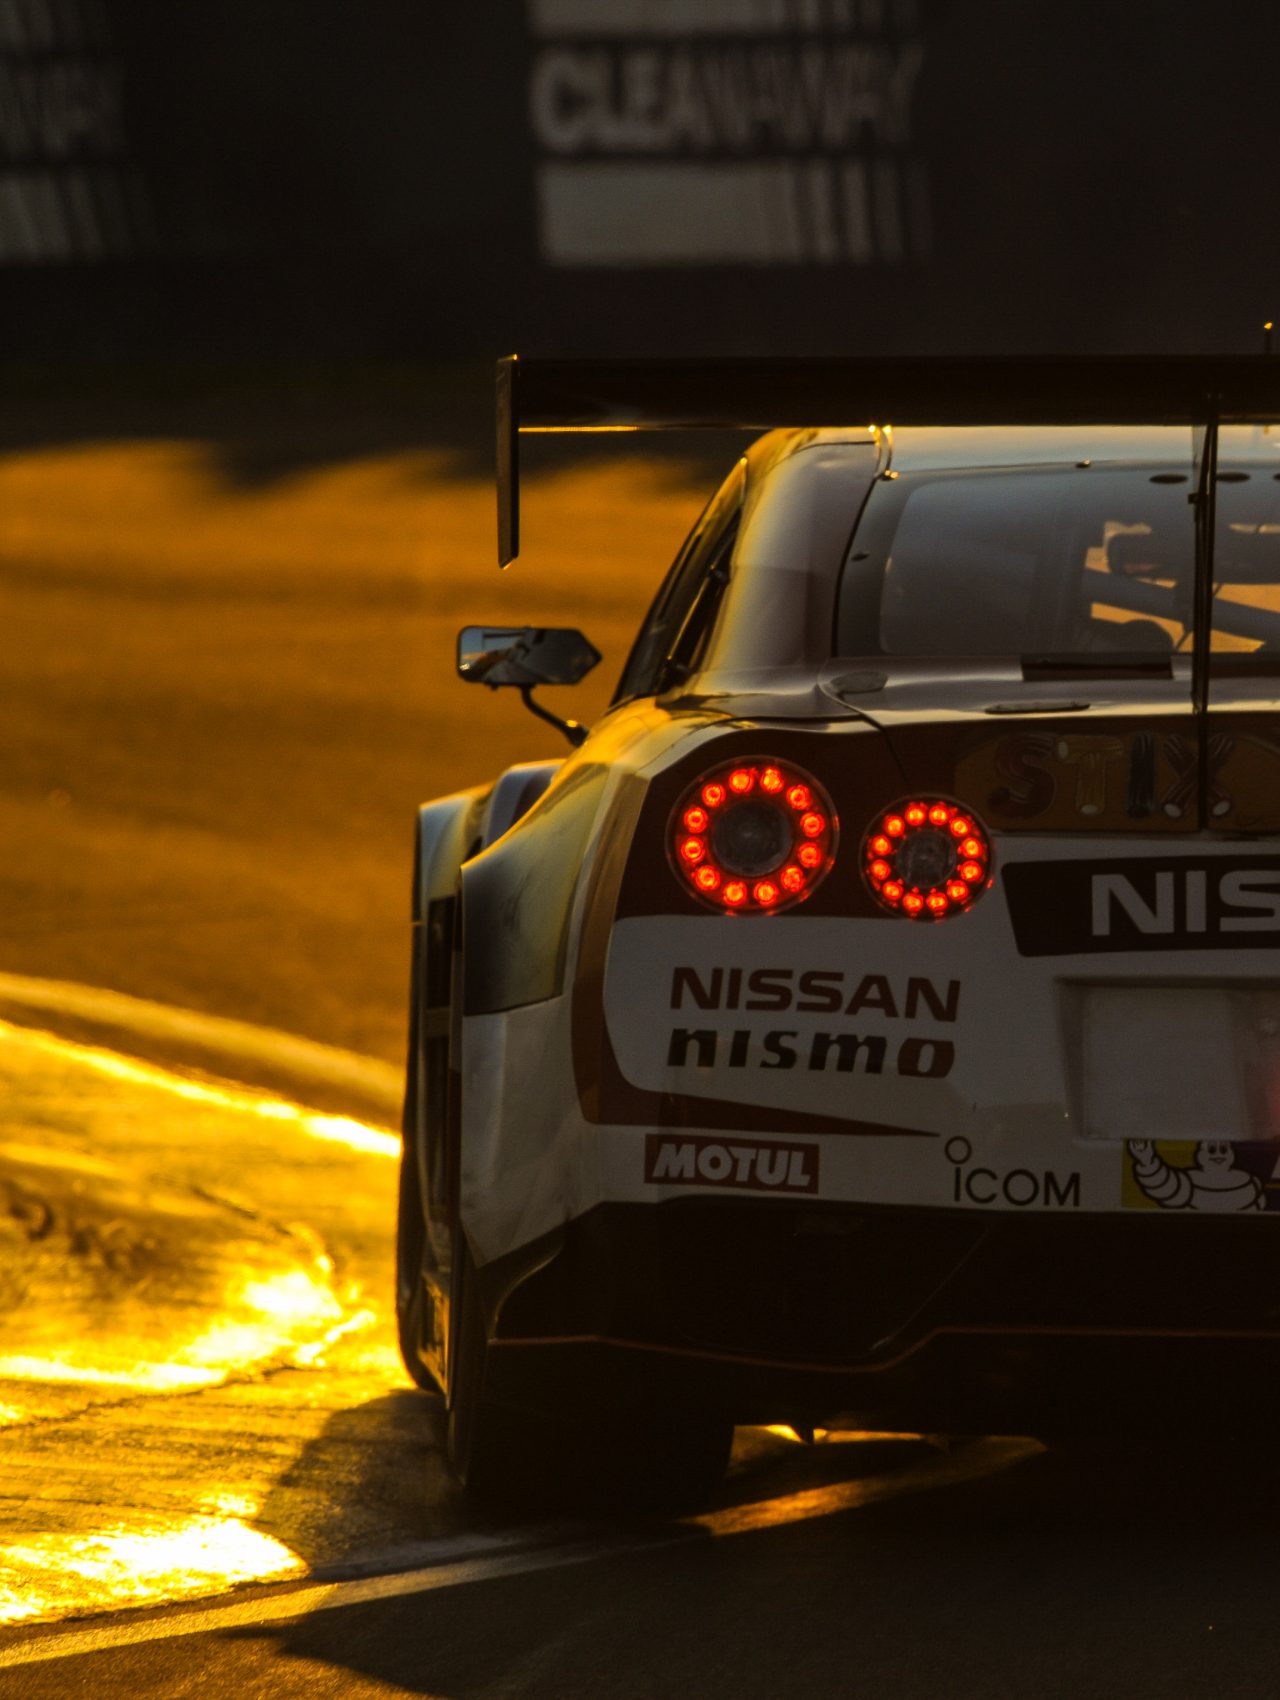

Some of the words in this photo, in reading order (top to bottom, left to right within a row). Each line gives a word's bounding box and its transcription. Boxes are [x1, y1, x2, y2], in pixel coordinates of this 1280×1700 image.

[670, 967, 961, 1022] NISSAN
[667, 1028, 956, 1079] nismo
[652, 1143, 812, 1187] MOTUL
